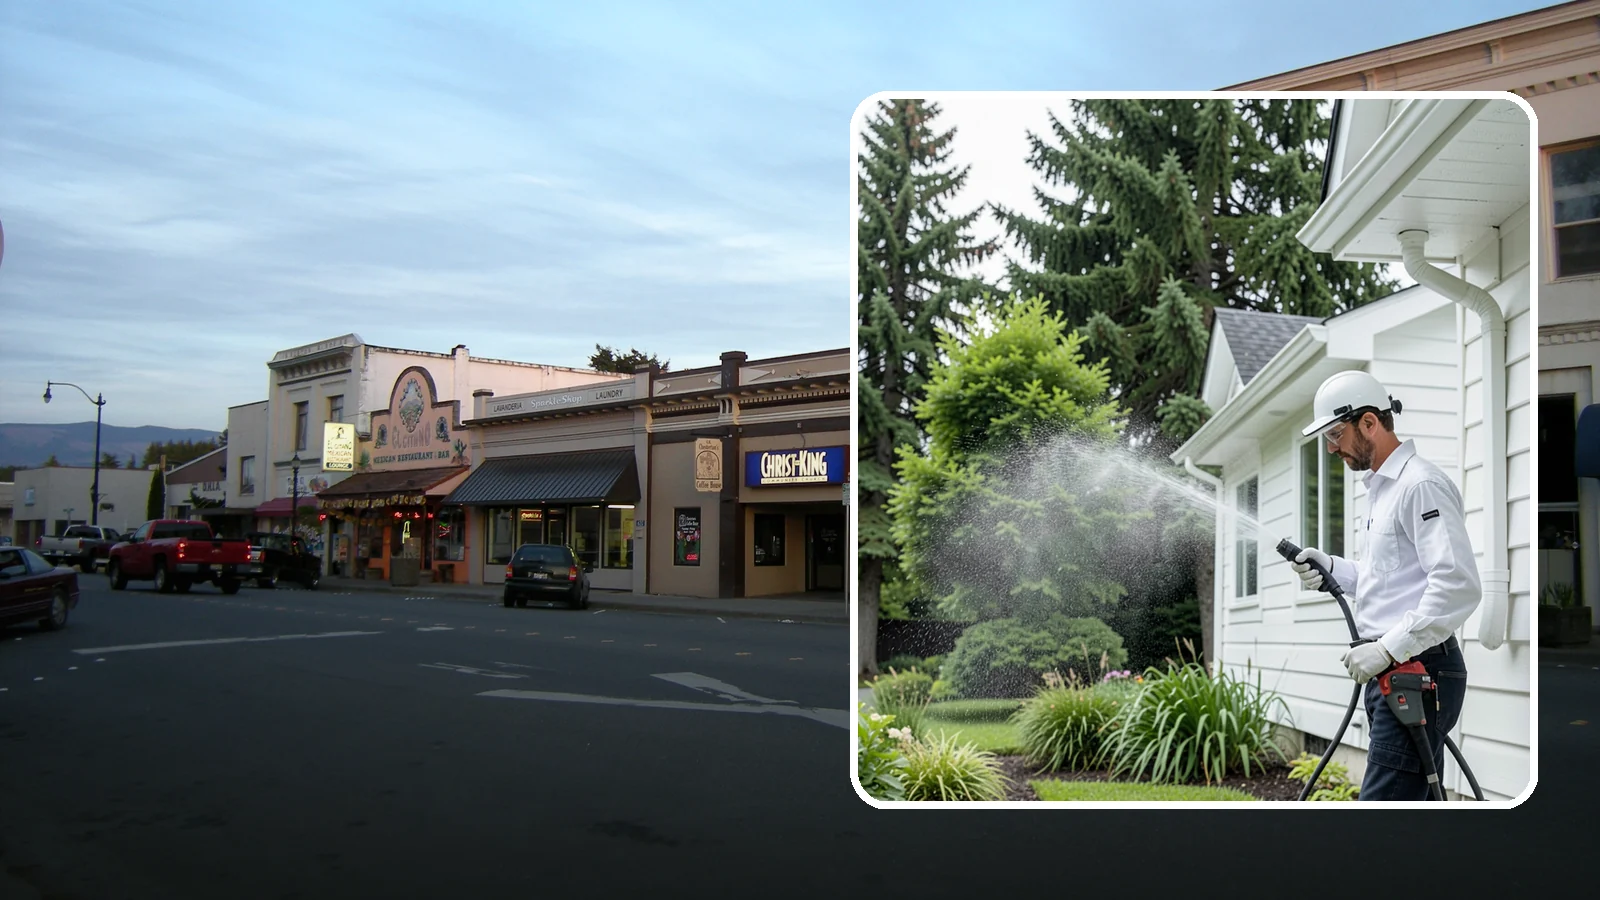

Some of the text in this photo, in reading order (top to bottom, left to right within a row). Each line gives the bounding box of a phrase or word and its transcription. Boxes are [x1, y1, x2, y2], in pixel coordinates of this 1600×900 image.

[493, 389, 624, 412] LAVANDERIA Sparkle Shop LAUNDRY
[373, 454, 396, 464] MEXICAN
[397, 452, 433, 462] RESTAURANT
[438, 450, 450, 459] BAR
[761, 450, 827, 478] CHRIST KING
